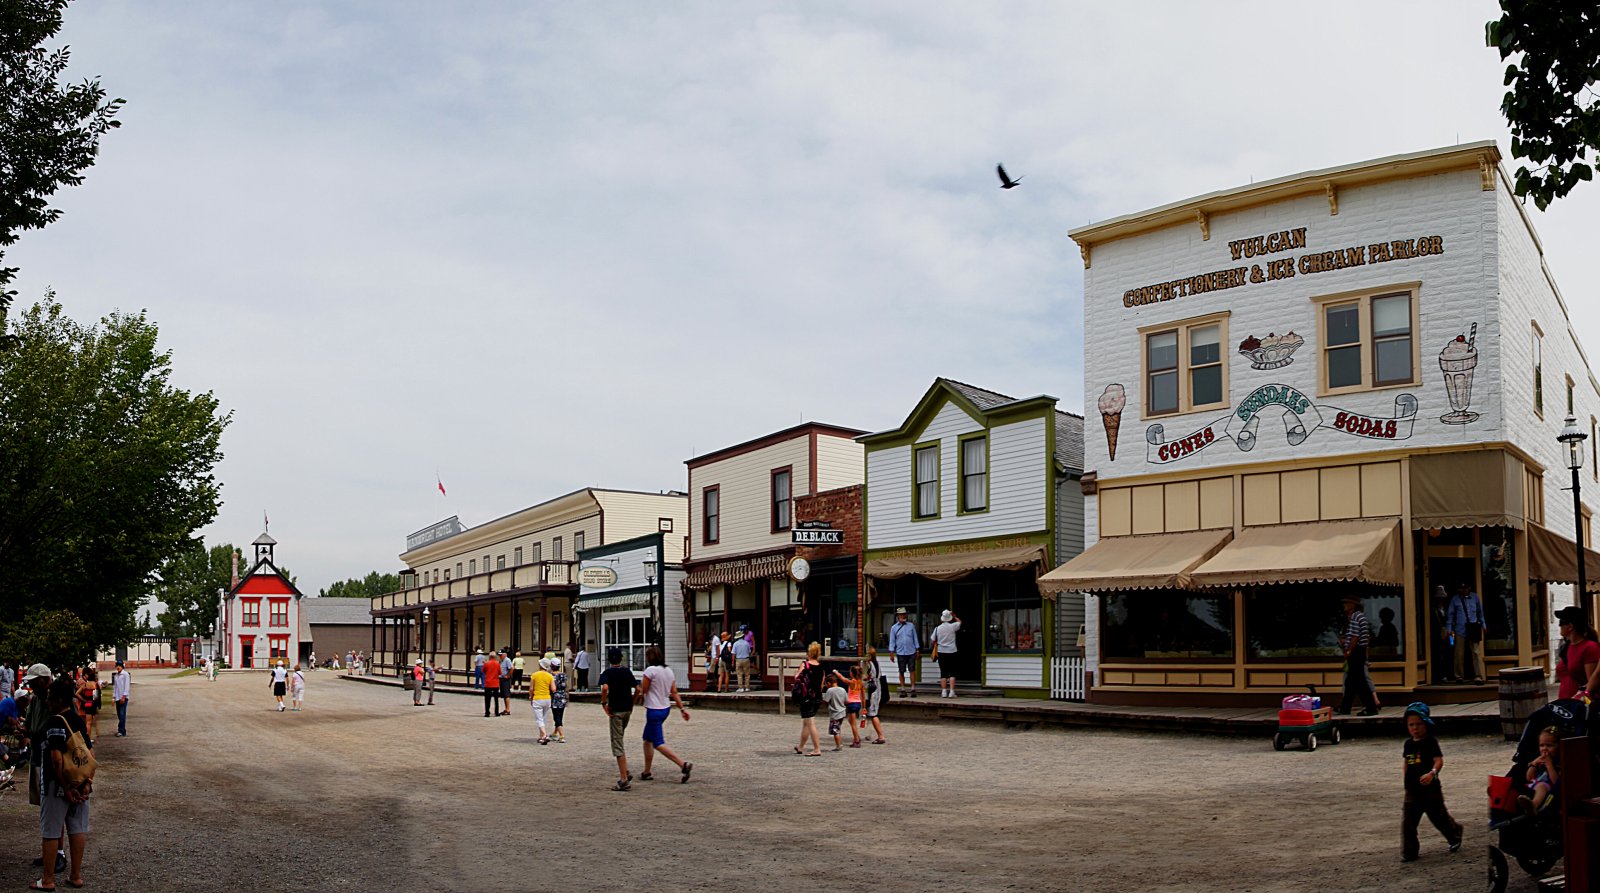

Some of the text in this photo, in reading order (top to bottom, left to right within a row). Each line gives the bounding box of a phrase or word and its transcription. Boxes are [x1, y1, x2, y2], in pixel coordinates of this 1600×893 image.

[1228, 227, 1307, 261] VULCAN
[1123, 235, 1444, 308] CONFECTIONERY & ICE CREAM PARLOR
[1237, 385, 1310, 422] SUNDAES
[1333, 411, 1398, 439] SODAS
[1158, 427, 1215, 462] CONES
[435, 522, 452, 539] HOTEL
[944, 541, 988, 554] GENERAL
[995, 536, 1030, 549] STORE
[751, 554, 785, 566] HARNESS
